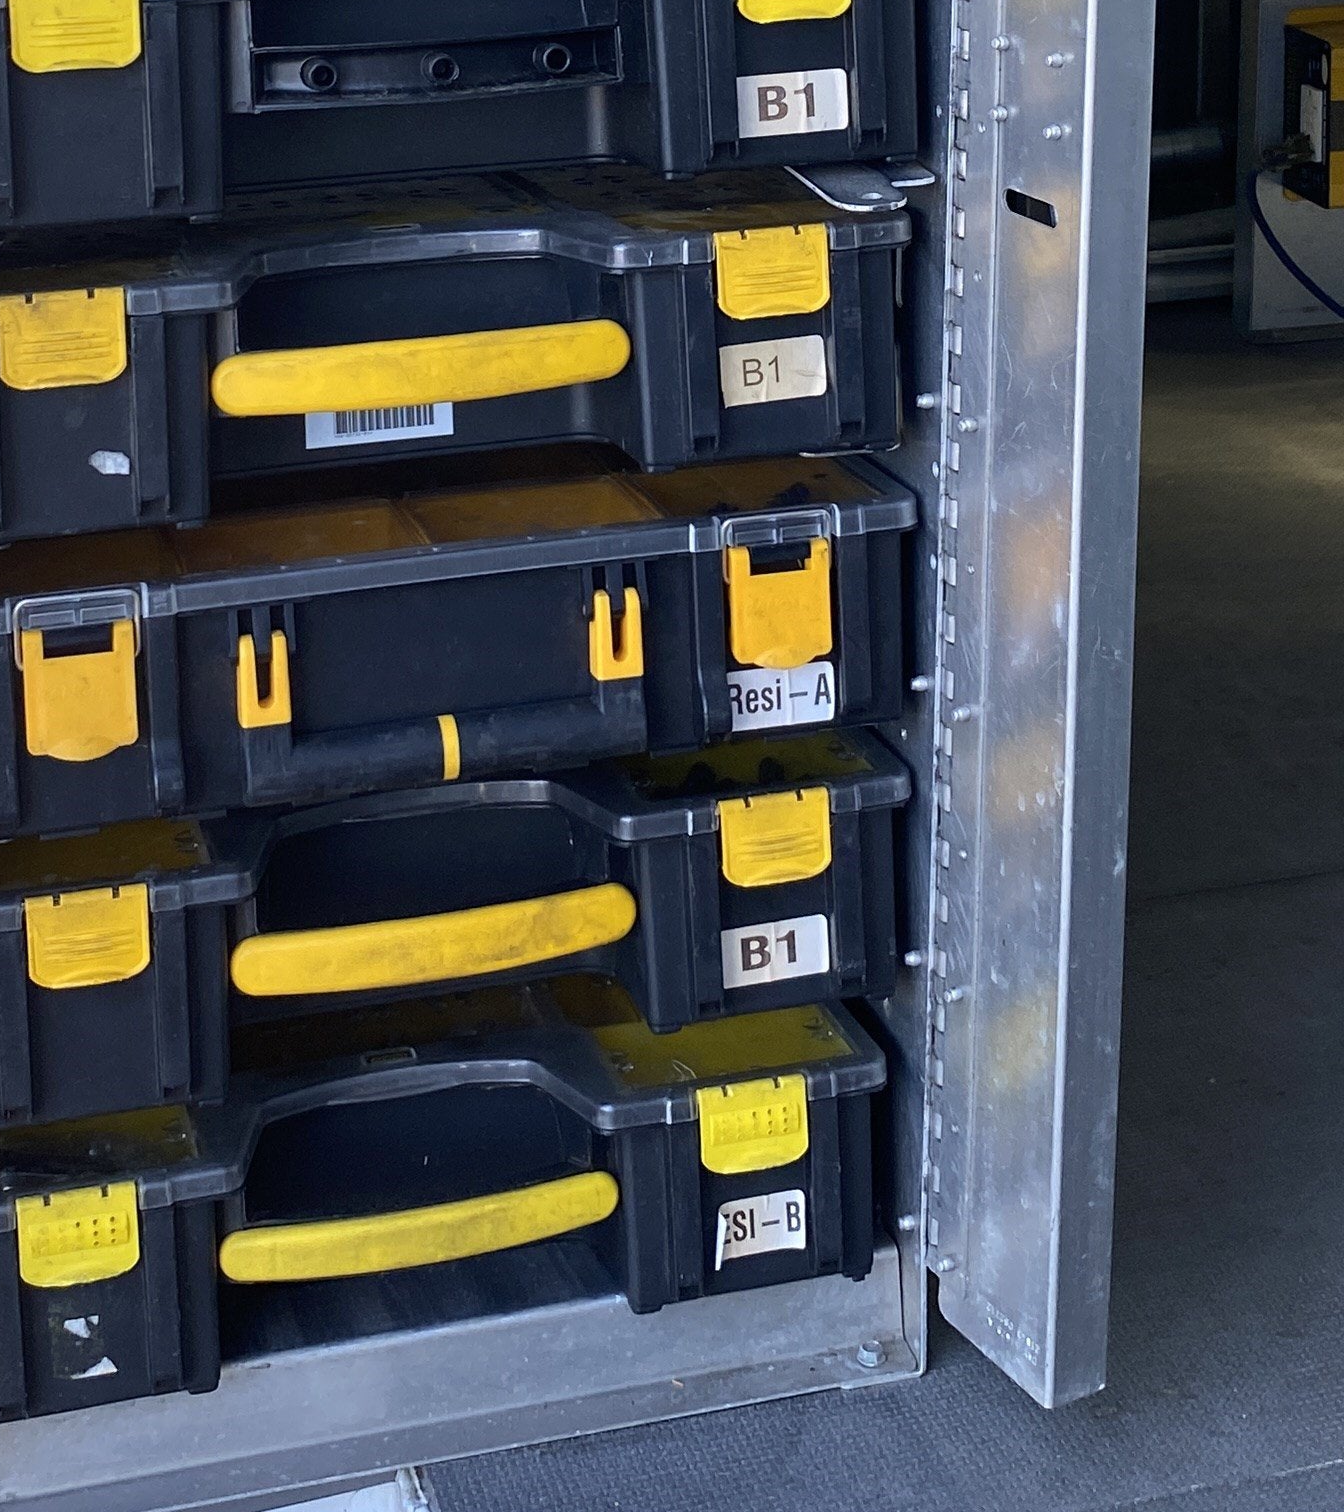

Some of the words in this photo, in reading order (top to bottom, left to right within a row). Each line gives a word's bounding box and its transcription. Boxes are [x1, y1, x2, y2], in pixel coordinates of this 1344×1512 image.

[757, 82, 816, 122] B1
[742, 355, 780, 388] B1
[740, 929, 797, 972] B1
